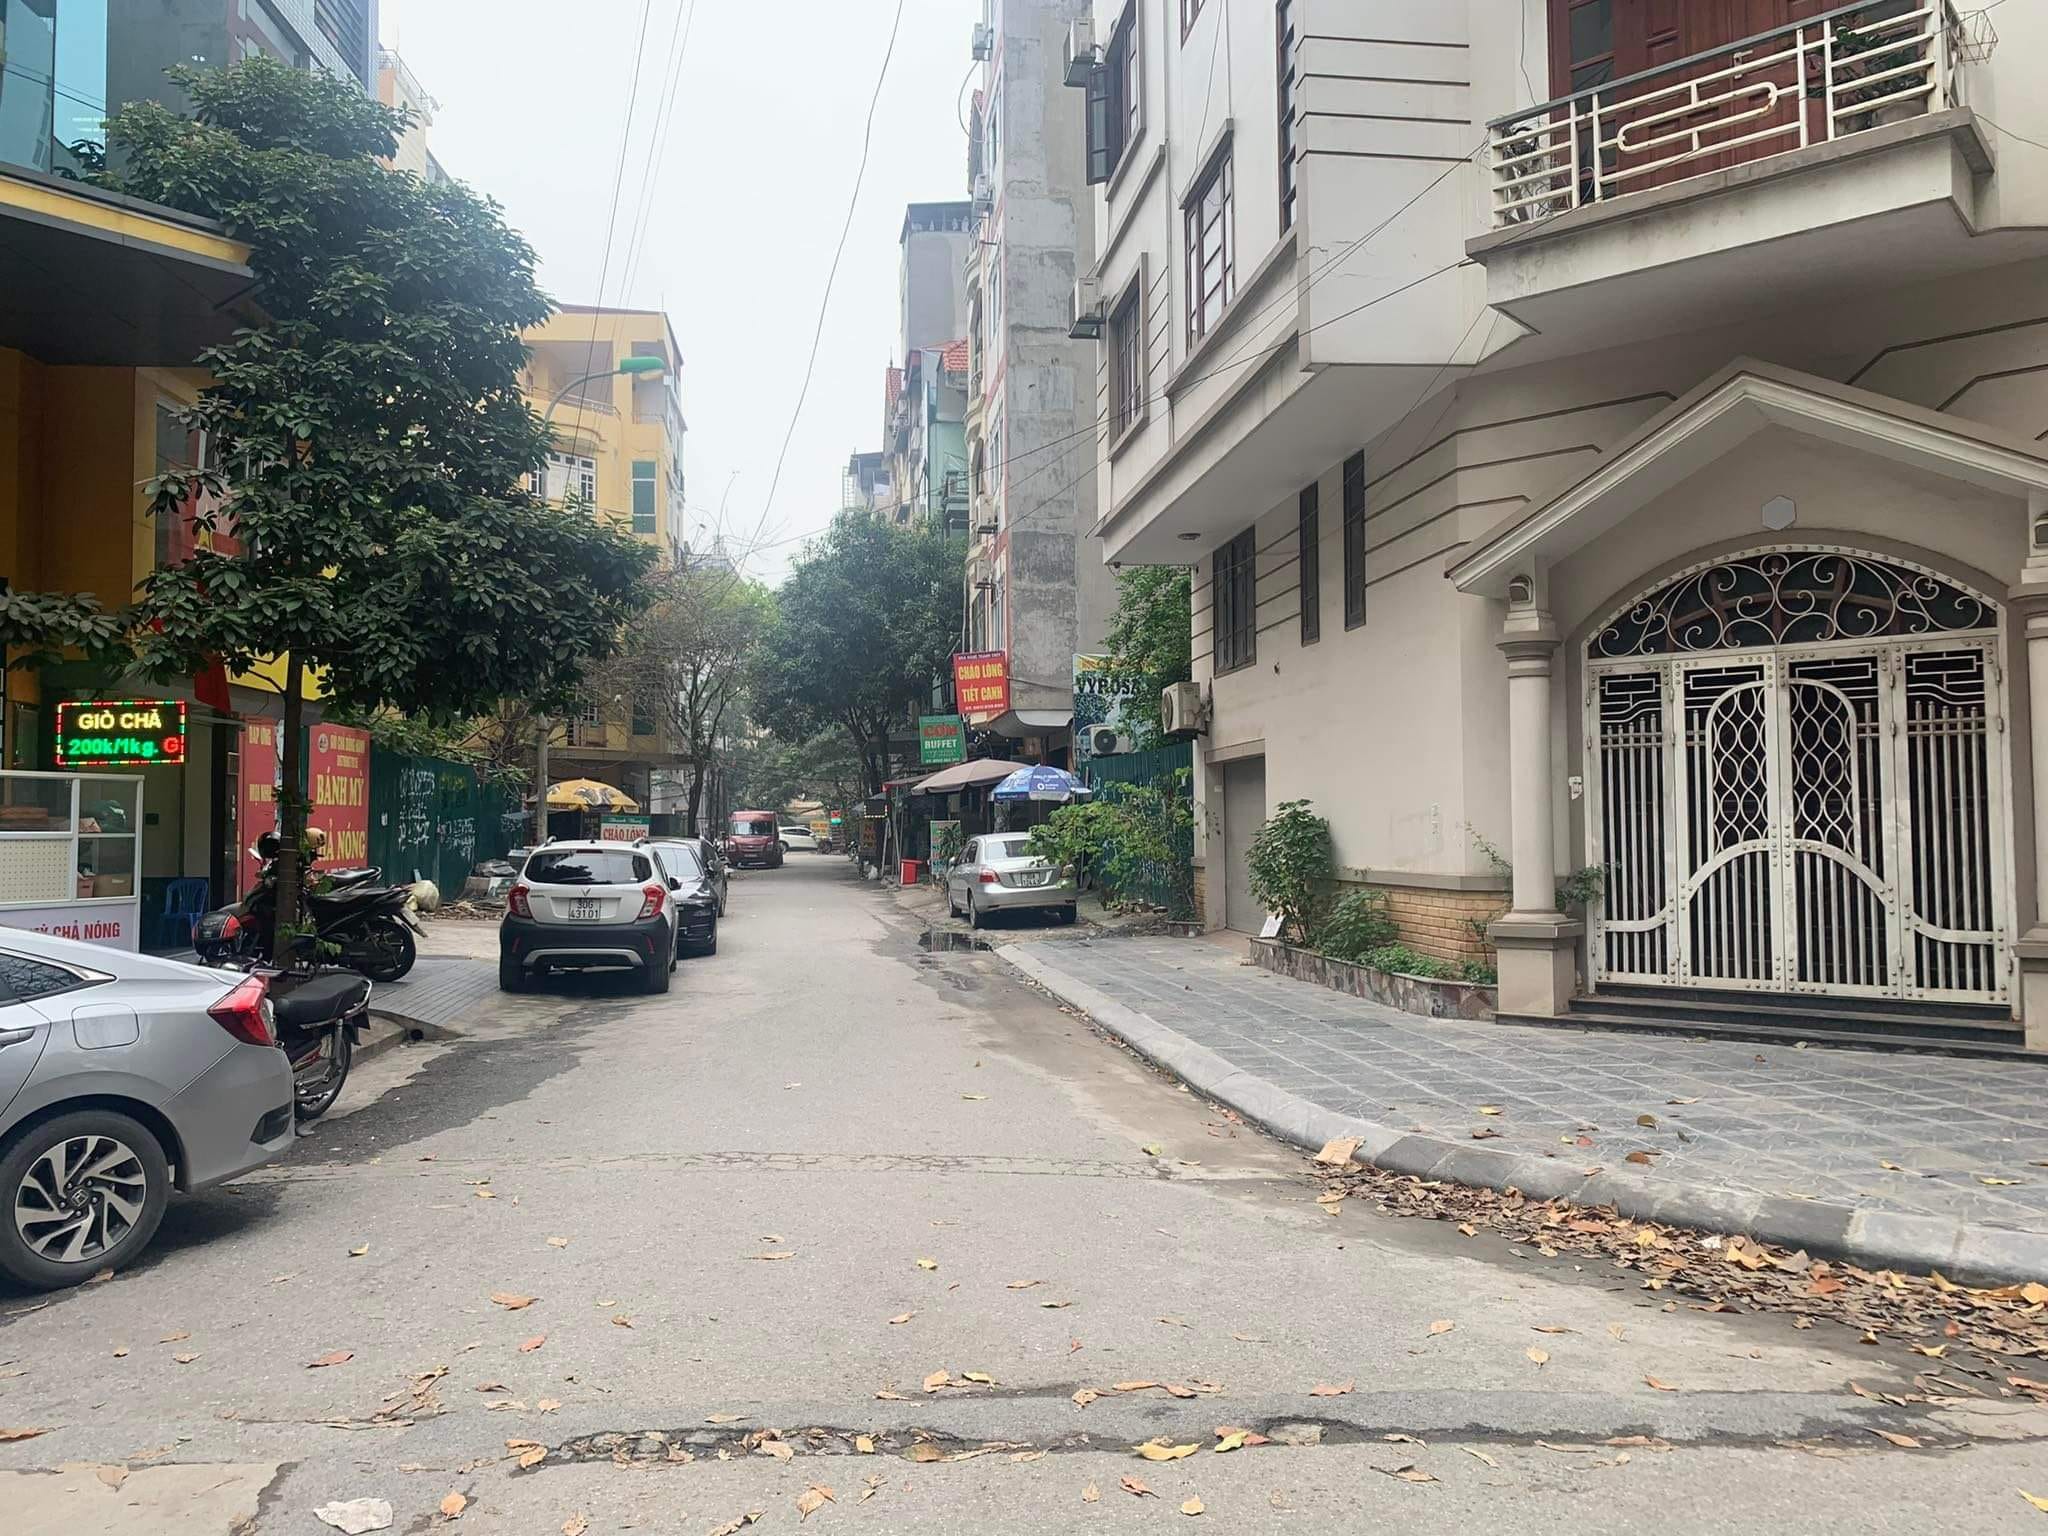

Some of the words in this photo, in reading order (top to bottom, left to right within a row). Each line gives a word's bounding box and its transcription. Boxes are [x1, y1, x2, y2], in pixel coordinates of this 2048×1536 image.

[78, 709, 116, 730] GIÒ
[119, 708, 163, 730] CHẢ
[924, 739, 958, 750] BUFFET
[316, 766, 347, 806] BÁNH
[349, 769, 364, 807] MỲ
[337, 822, 366, 861] NÓNG
[53, 919, 80, 940] CHẢ
[84, 919, 120, 939] NÓNG
